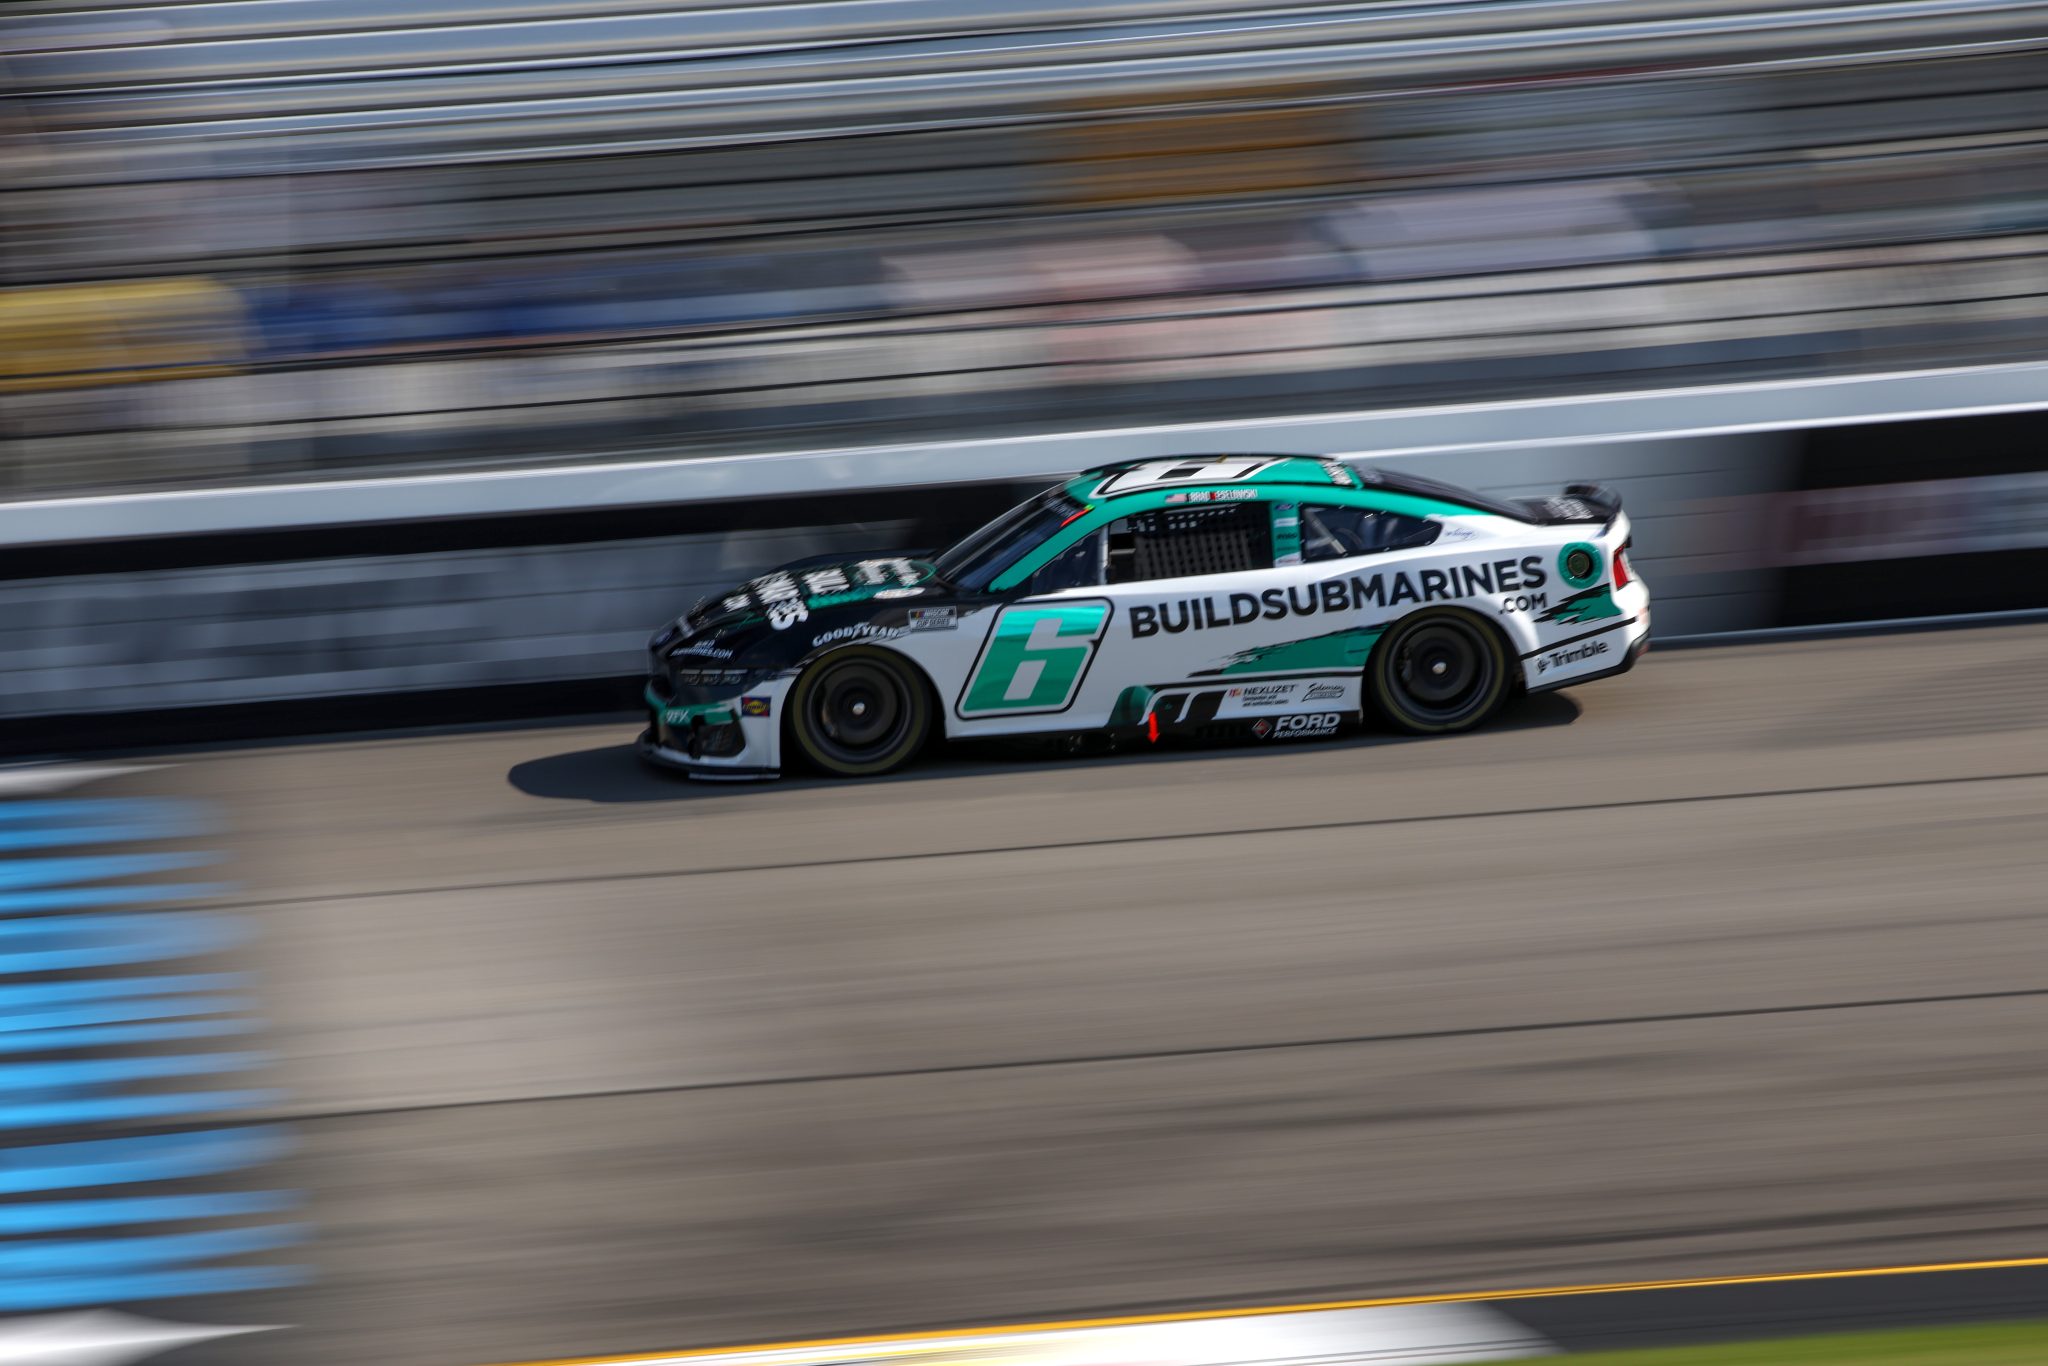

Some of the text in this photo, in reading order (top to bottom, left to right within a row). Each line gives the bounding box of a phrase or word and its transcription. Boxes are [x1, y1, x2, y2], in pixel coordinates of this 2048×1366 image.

[1129, 556, 1547, 640] BUILDSUBMARINES
[1499, 592, 1547, 615] .COM
[812, 621, 900, 648] GOODYEAR
[963, 605, 1106, 712] 6
[1549, 640, 1609, 668] Trimble
[1272, 727, 1337, 739] PERFORMANCE
[1275, 713, 1340, 731] FORD
